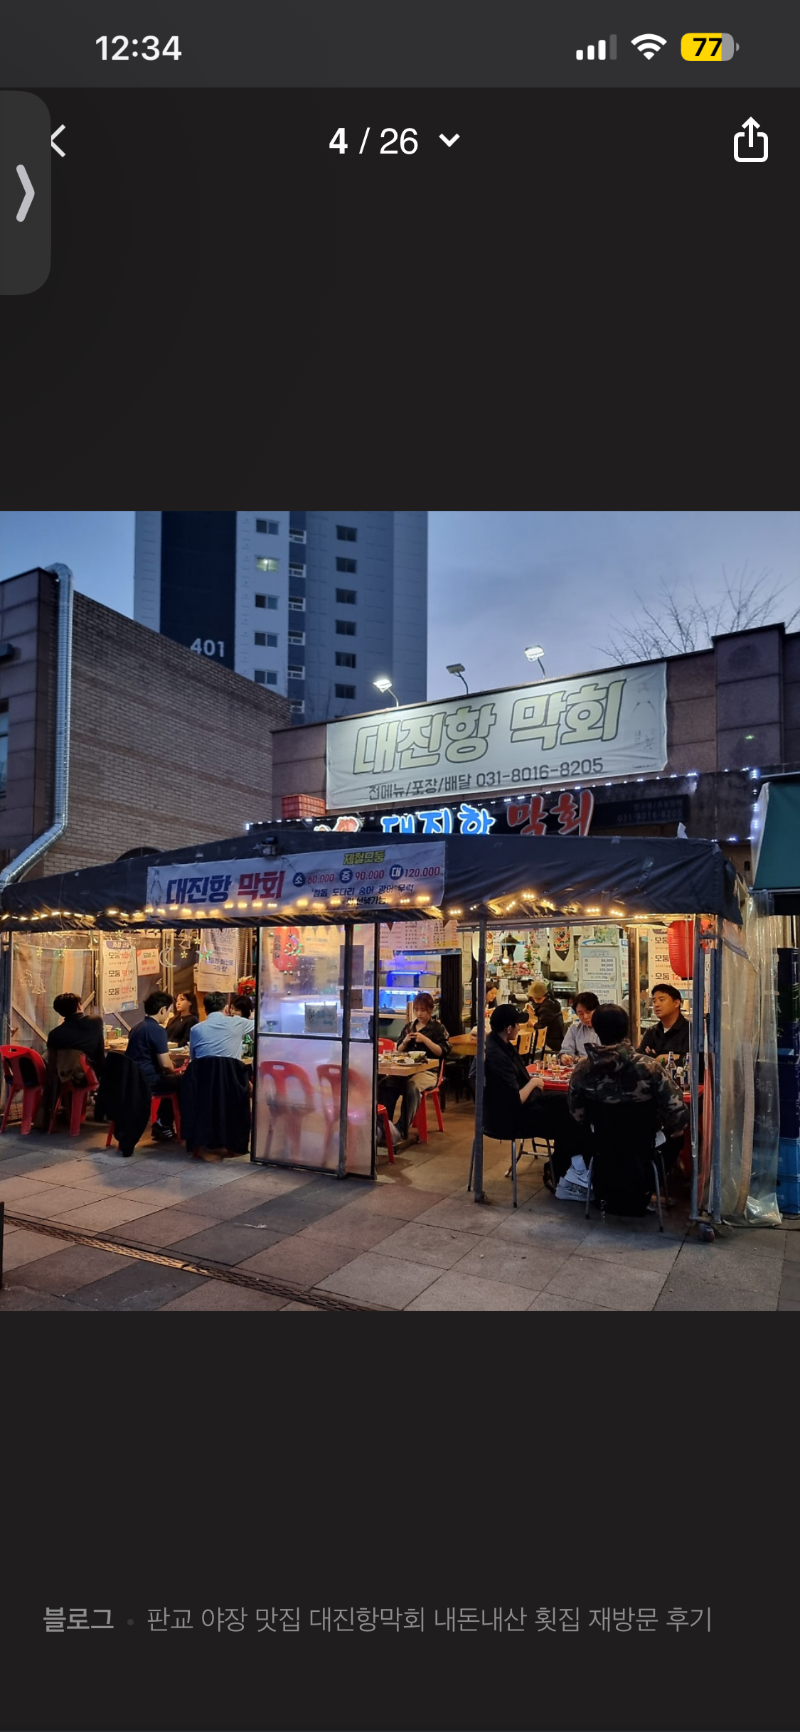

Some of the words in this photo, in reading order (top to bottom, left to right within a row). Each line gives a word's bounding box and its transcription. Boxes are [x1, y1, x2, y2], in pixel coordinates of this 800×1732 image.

[190, 637, 225, 658] 401
[353, 703, 497, 775] 대진항
[510, 679, 627, 750] 막회
[368, 773, 472, 801] 전메뉴/포장/배달
[476, 758, 603, 787] 031-8016-8205
[507, 789, 594, 836] 막회
[343, 850, 386, 865] 제철모둠
[166, 875, 232, 904] 대진항
[237, 871, 286, 900] 막회
[332, 888, 355, 896] 도다리
[359, 887, 374, 895] 숭어
